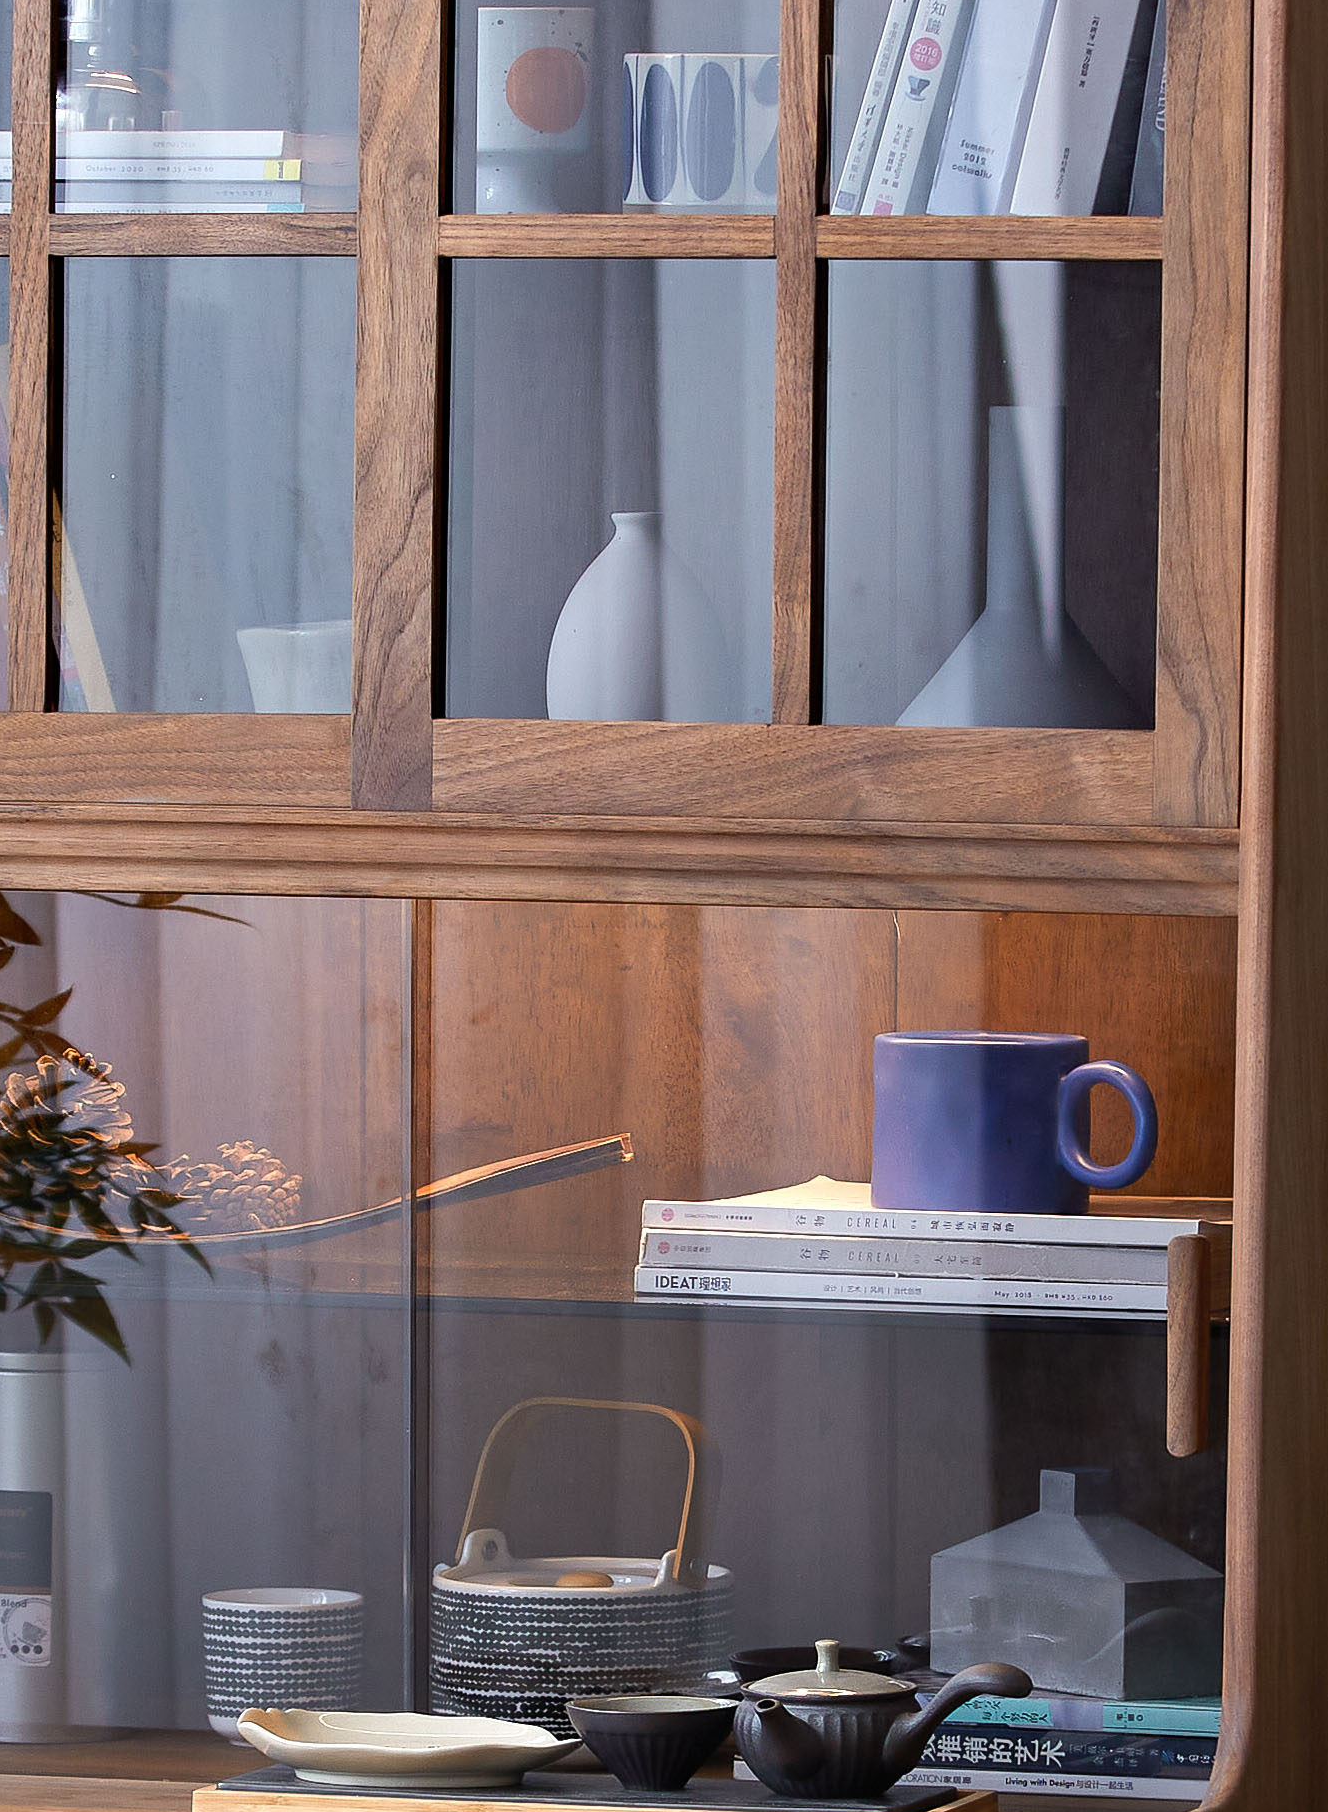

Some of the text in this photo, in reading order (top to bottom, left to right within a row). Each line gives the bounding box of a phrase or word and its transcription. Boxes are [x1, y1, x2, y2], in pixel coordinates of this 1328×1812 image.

[914, 43, 939, 57] 2016
[959, 138, 994, 156] Summer
[963, 152, 987, 166] 2012
[795, 1214, 826, 1227] 谷物
[847, 1217, 896, 1230] CEREAL
[799, 1247, 831, 1261] 谷物
[847, 1250, 899, 1264] CEREAL
[655, 1275, 732, 1292] IDEAT理想家
[994, 1290, 1010, 1300] May
[1005, 1776, 1029, 1788] Living
[1030, 1777, 1047, 1787] with
